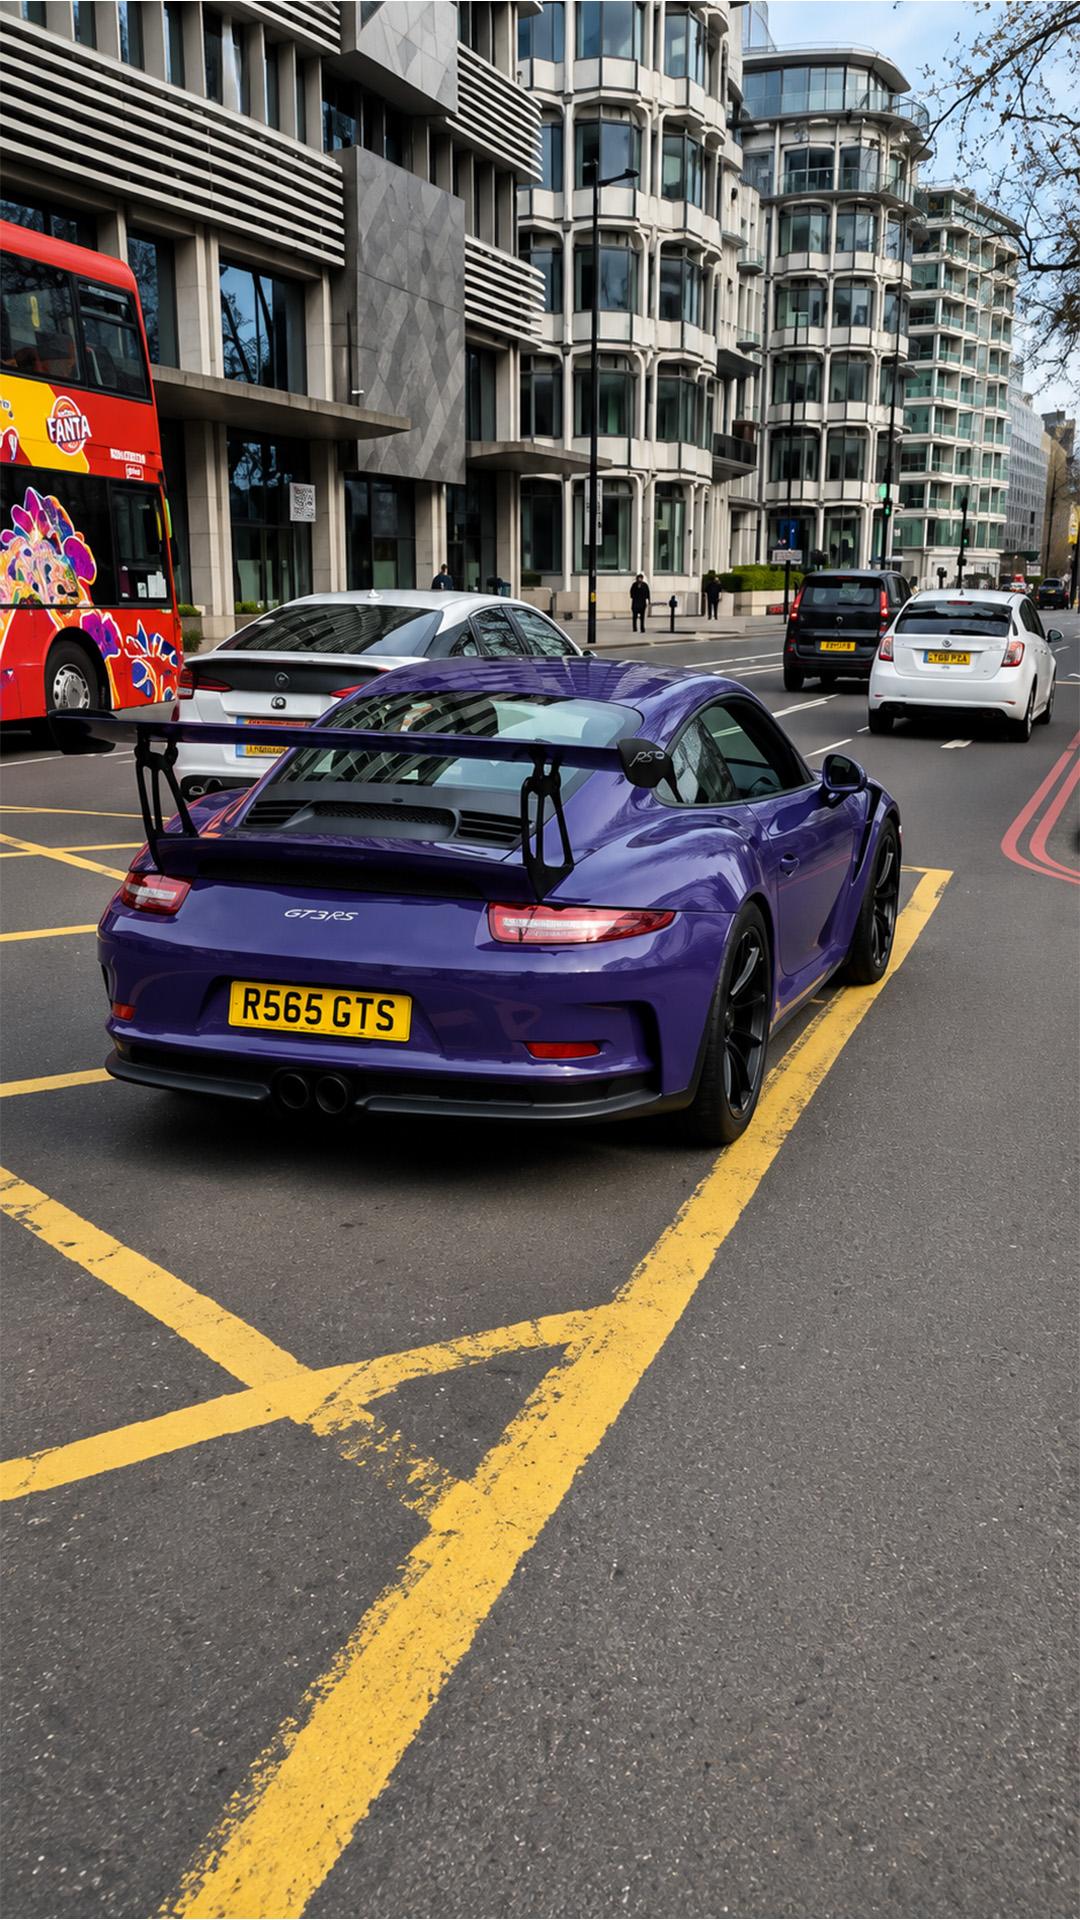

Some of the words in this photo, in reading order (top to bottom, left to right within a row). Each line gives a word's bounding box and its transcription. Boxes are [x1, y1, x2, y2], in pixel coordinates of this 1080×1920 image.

[47, 415, 92, 442] FANTA
[243, 988, 323, 1025] R565
[333, 996, 395, 1031] GTS
